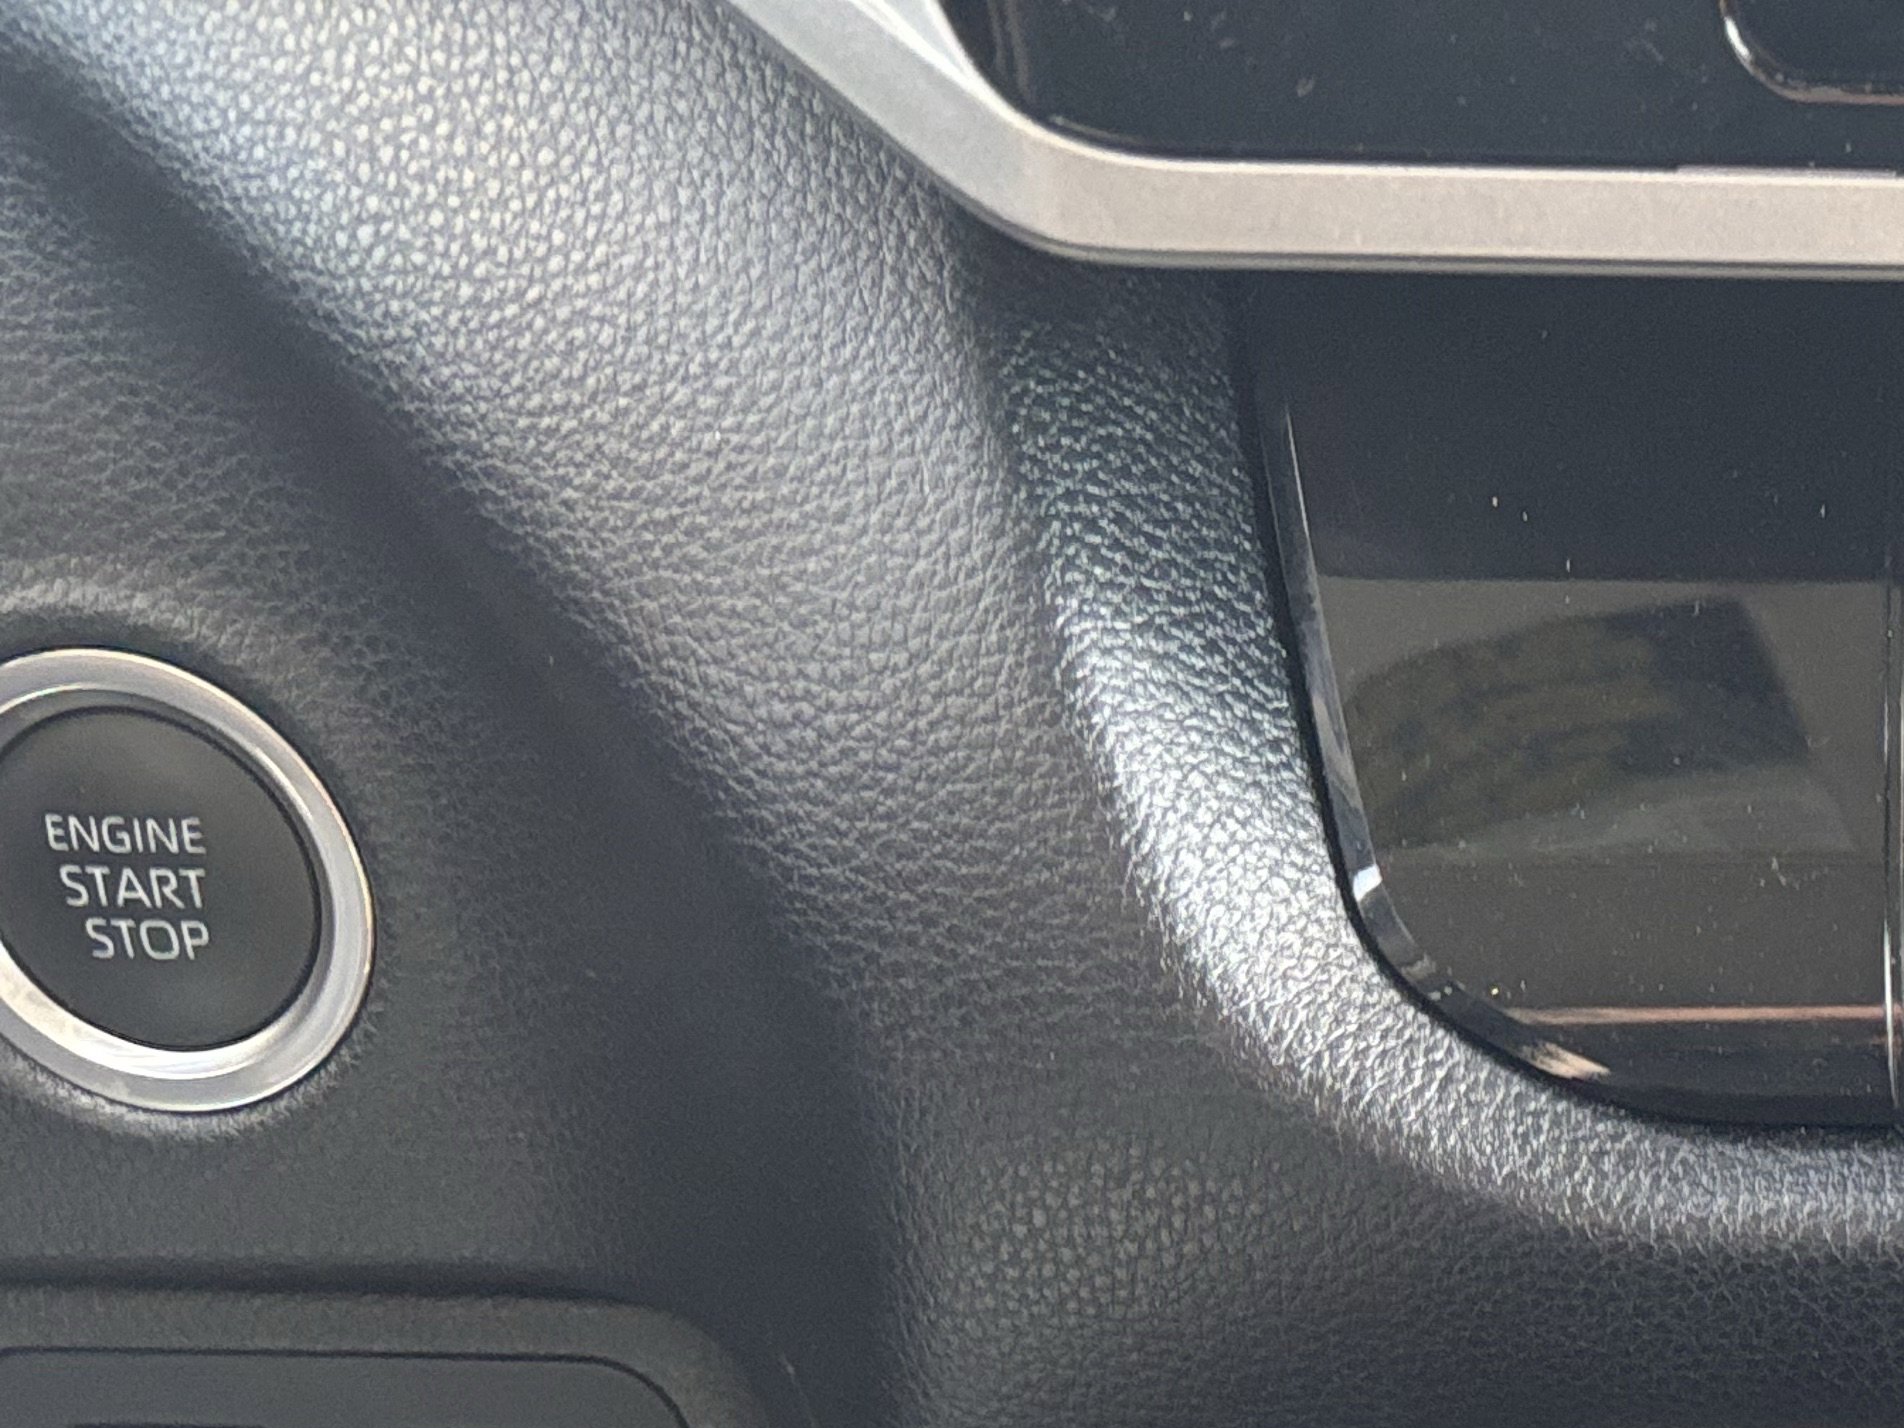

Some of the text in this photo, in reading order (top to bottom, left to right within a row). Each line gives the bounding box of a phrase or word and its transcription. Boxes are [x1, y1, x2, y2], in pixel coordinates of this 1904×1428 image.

[44, 812, 208, 855] ENGINE
[58, 864, 207, 910] START
[84, 916, 211, 961] STOP
